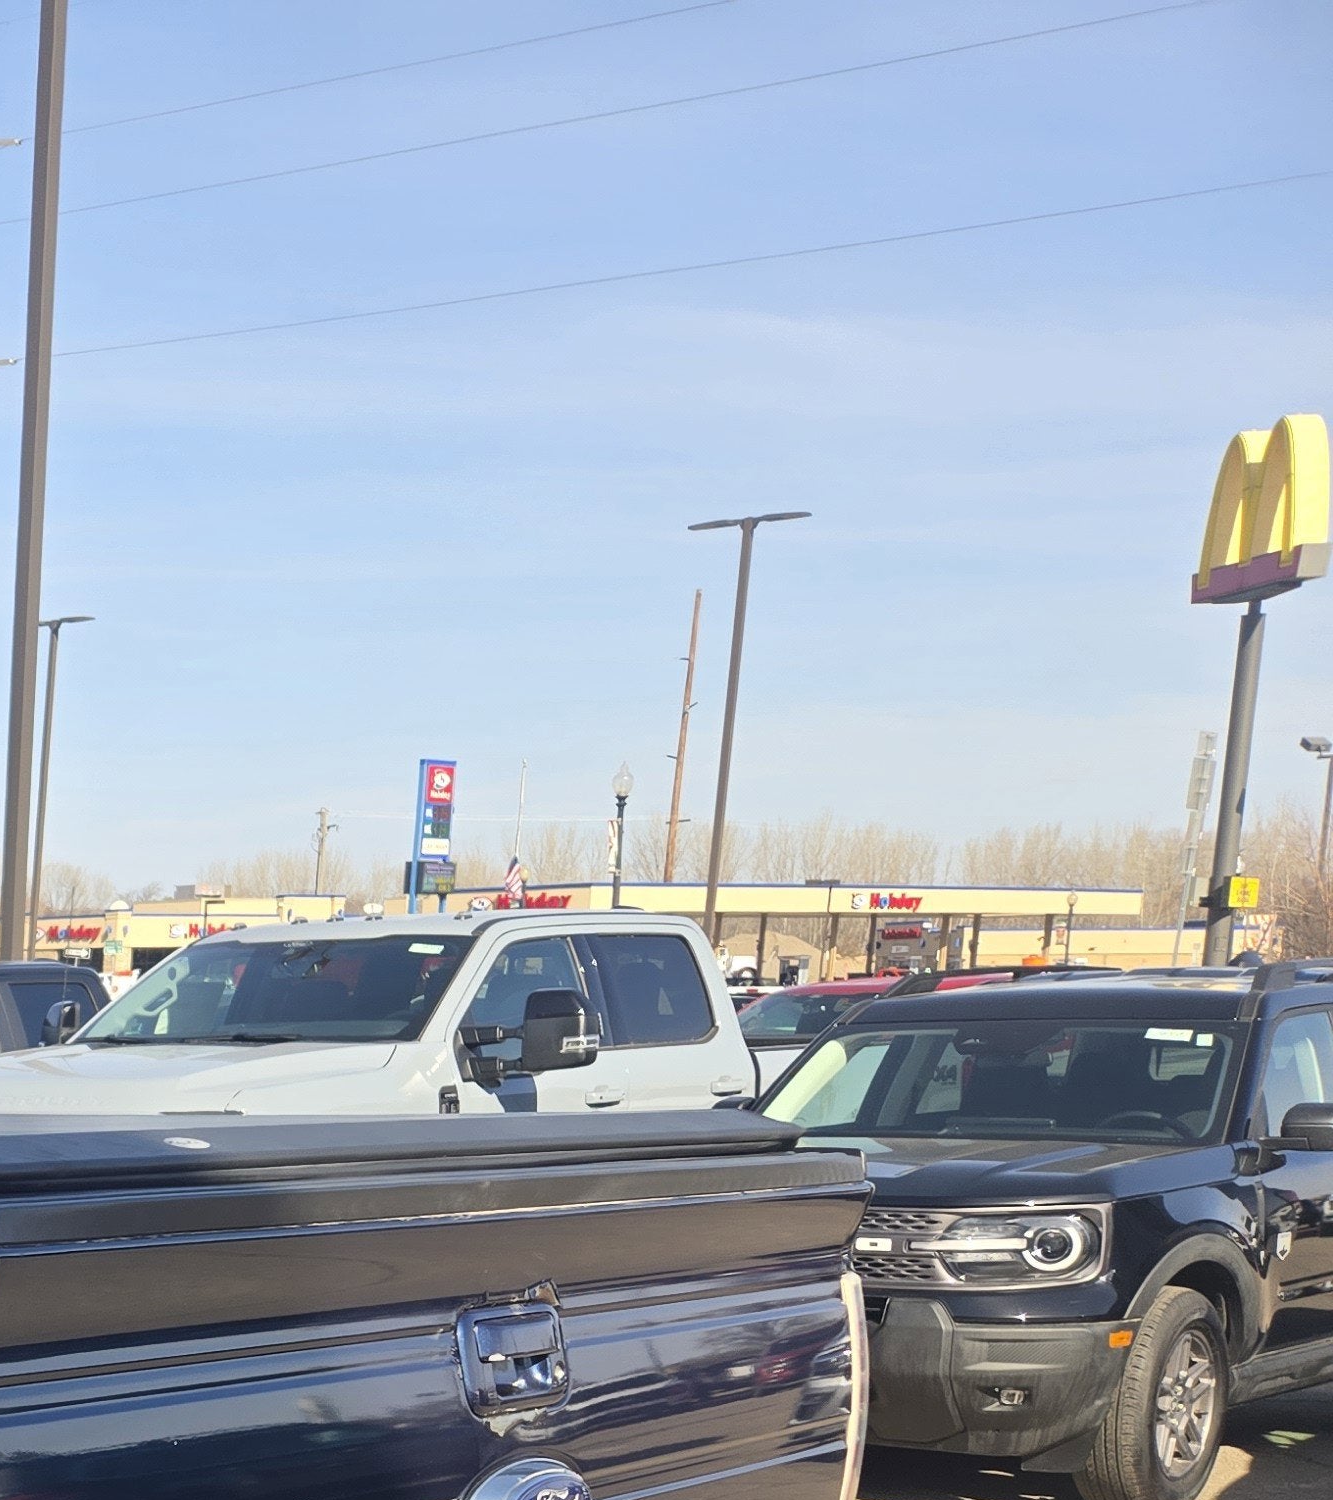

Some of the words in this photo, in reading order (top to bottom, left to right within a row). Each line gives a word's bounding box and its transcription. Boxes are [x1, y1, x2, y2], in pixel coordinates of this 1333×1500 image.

[496, 892, 571, 909] Hliday
[869, 893, 923, 912] Holiday
[46, 925, 101, 944] Holiday
